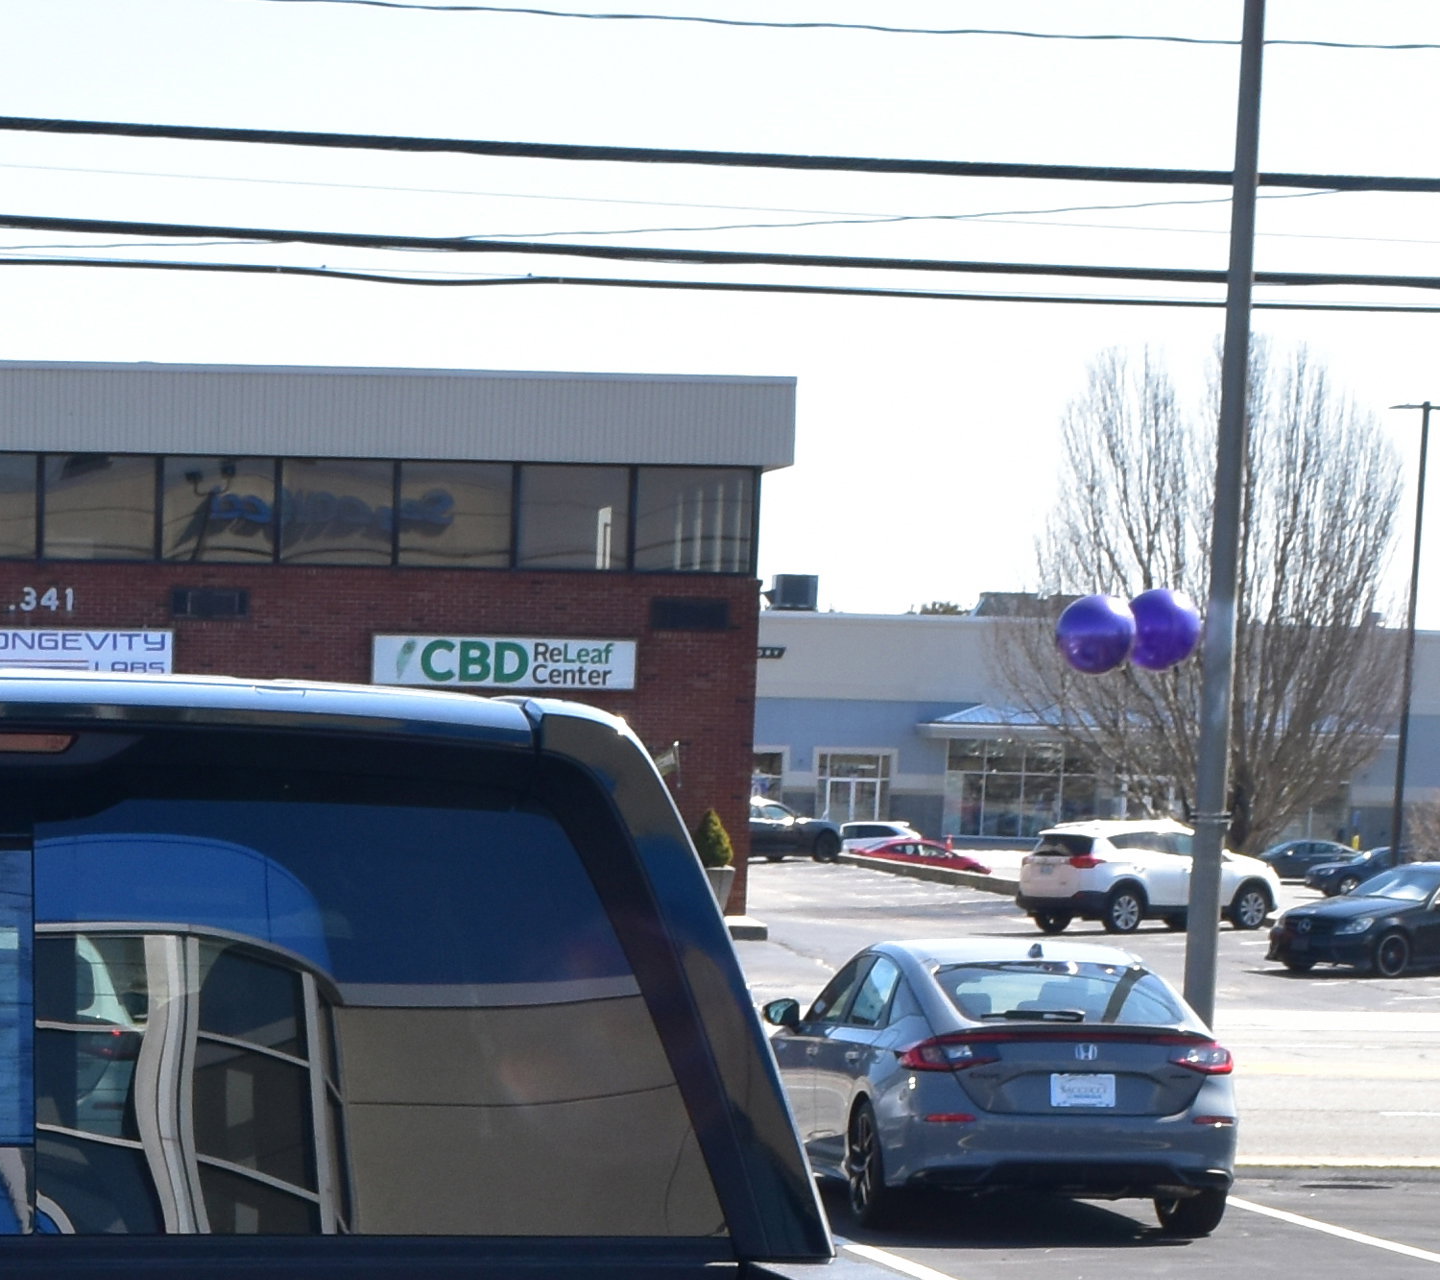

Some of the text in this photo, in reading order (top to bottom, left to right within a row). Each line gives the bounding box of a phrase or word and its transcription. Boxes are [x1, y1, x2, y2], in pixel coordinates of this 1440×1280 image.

[420, 639, 616, 684] CBD ReLeaf
[531, 663, 613, 686] Center
